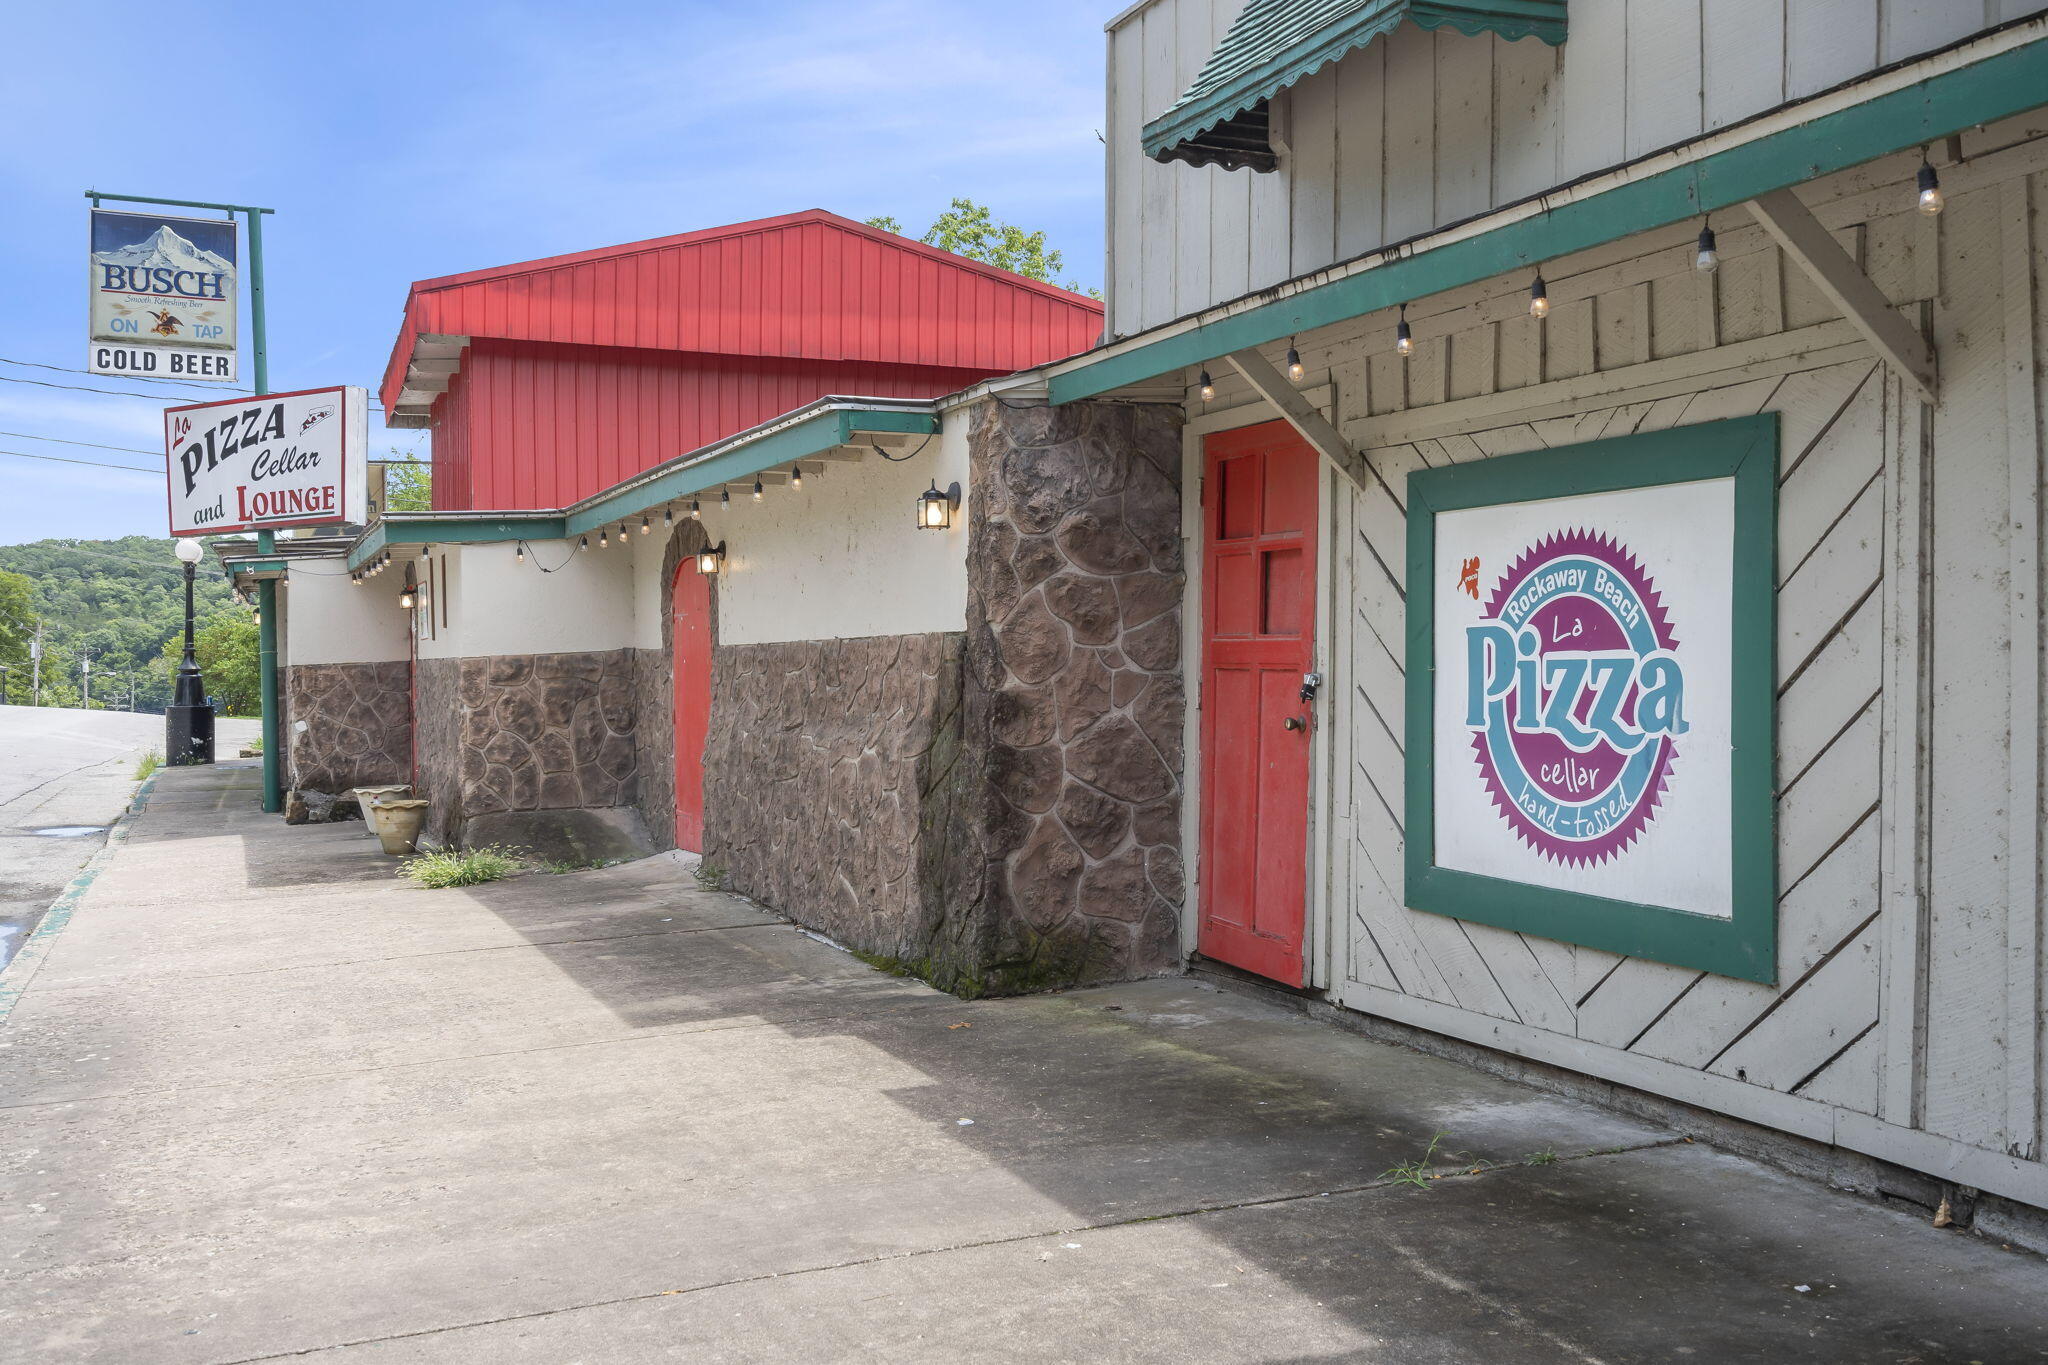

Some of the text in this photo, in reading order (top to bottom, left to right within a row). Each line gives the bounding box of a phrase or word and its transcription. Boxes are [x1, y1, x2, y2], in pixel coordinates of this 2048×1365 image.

[102, 264, 225, 298] BUSCH
[154, 296, 187, 308] Refreshing
[189, 300, 203, 308] Beer
[110, 318, 223, 339] ON TAP
[97, 348, 229, 376] COLD BEER
[180, 403, 286, 499] PIZZA
[250, 445, 322, 482] Cellar
[193, 494, 226, 526] and
[1507, 568, 1640, 630] Rockaway Beach
[1553, 616, 1583, 643] La
[1465, 624, 1690, 751] Pizza
[1541, 757, 1600, 793] cellar
